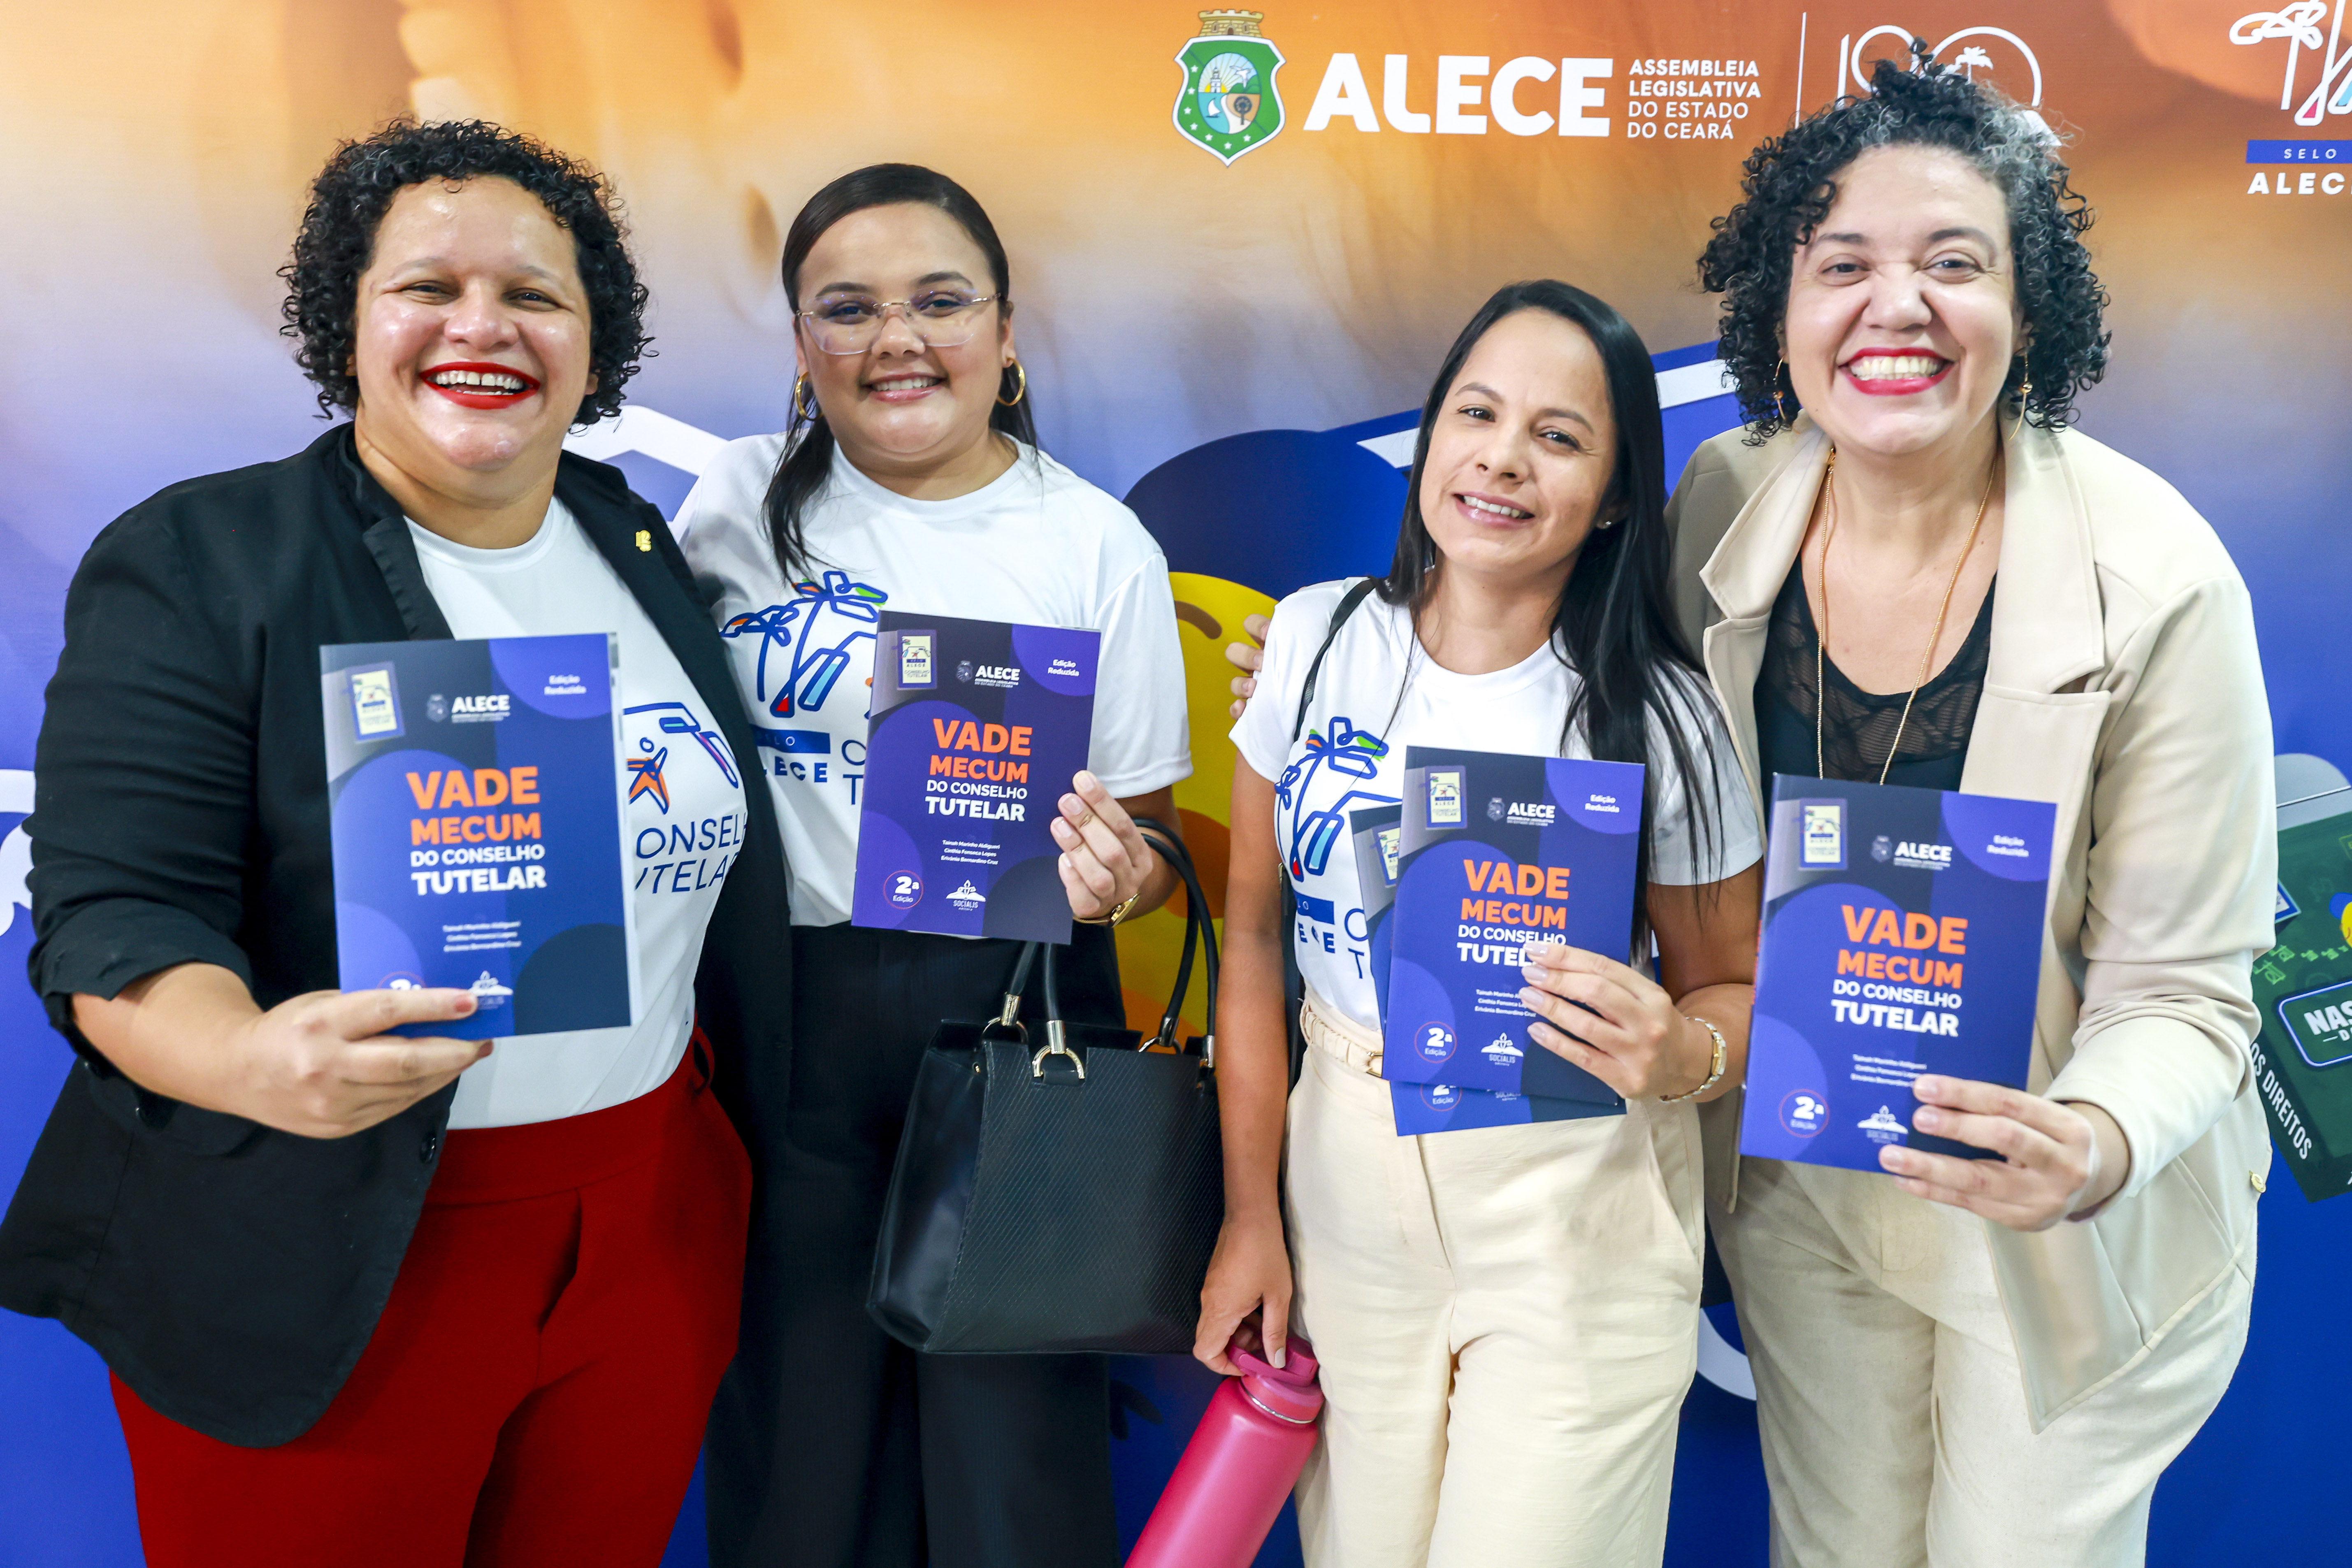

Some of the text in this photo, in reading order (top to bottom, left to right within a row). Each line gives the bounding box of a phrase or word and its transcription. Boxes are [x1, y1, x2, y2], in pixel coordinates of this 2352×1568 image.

[1629, 59, 1760, 77] ASSEMBLEIA
[1303, 53, 1614, 137] ALECE
[1629, 80, 1761, 98] LEGISLATIVA
[1628, 101, 1748, 119] DO ESTADO
[1627, 119, 1734, 139] DO CEARÁ
[2284, 149, 2337, 159] SELO
[2247, 172, 2352, 195] ALEC
[975, 665, 1021, 681] ALECE
[1047, 667, 1080, 676] Reduzida
[1053, 659, 1076, 668] Edição
[452, 695, 511, 713] ALECE
[933, 718, 1033, 756] VADE
[763, 756, 828, 783] ECE
[929, 755, 1029, 784] MECUM
[406, 766, 541, 810] VADE
[926, 779, 1028, 800] DO CONSELHO
[925, 796, 1025, 822] TUTELAR
[1507, 802, 1556, 819] ALECE
[411, 812, 542, 846] MECUM
[636, 812, 747, 859] ONSEL
[410, 844, 546, 867] DO CONSELHO
[1894, 841, 1953, 862] ALECE
[411, 864, 548, 896] TUTELAR
[634, 851, 739, 894] TELA
[1463, 859, 1570, 900] VADE
[1461, 898, 1567, 929] MECUM
[1458, 925, 1567, 945] DO CONSELHO
[1841, 905, 1969, 955] VADE
[1456, 942, 1534, 967] TUTEL
[1837, 949, 1964, 989] MECUM
[1832, 979, 1962, 1009] DO CONSELHO
[1831, 999, 1959, 1037] TUTELAR
[2262, 1069, 2312, 1159] DIREITOS
